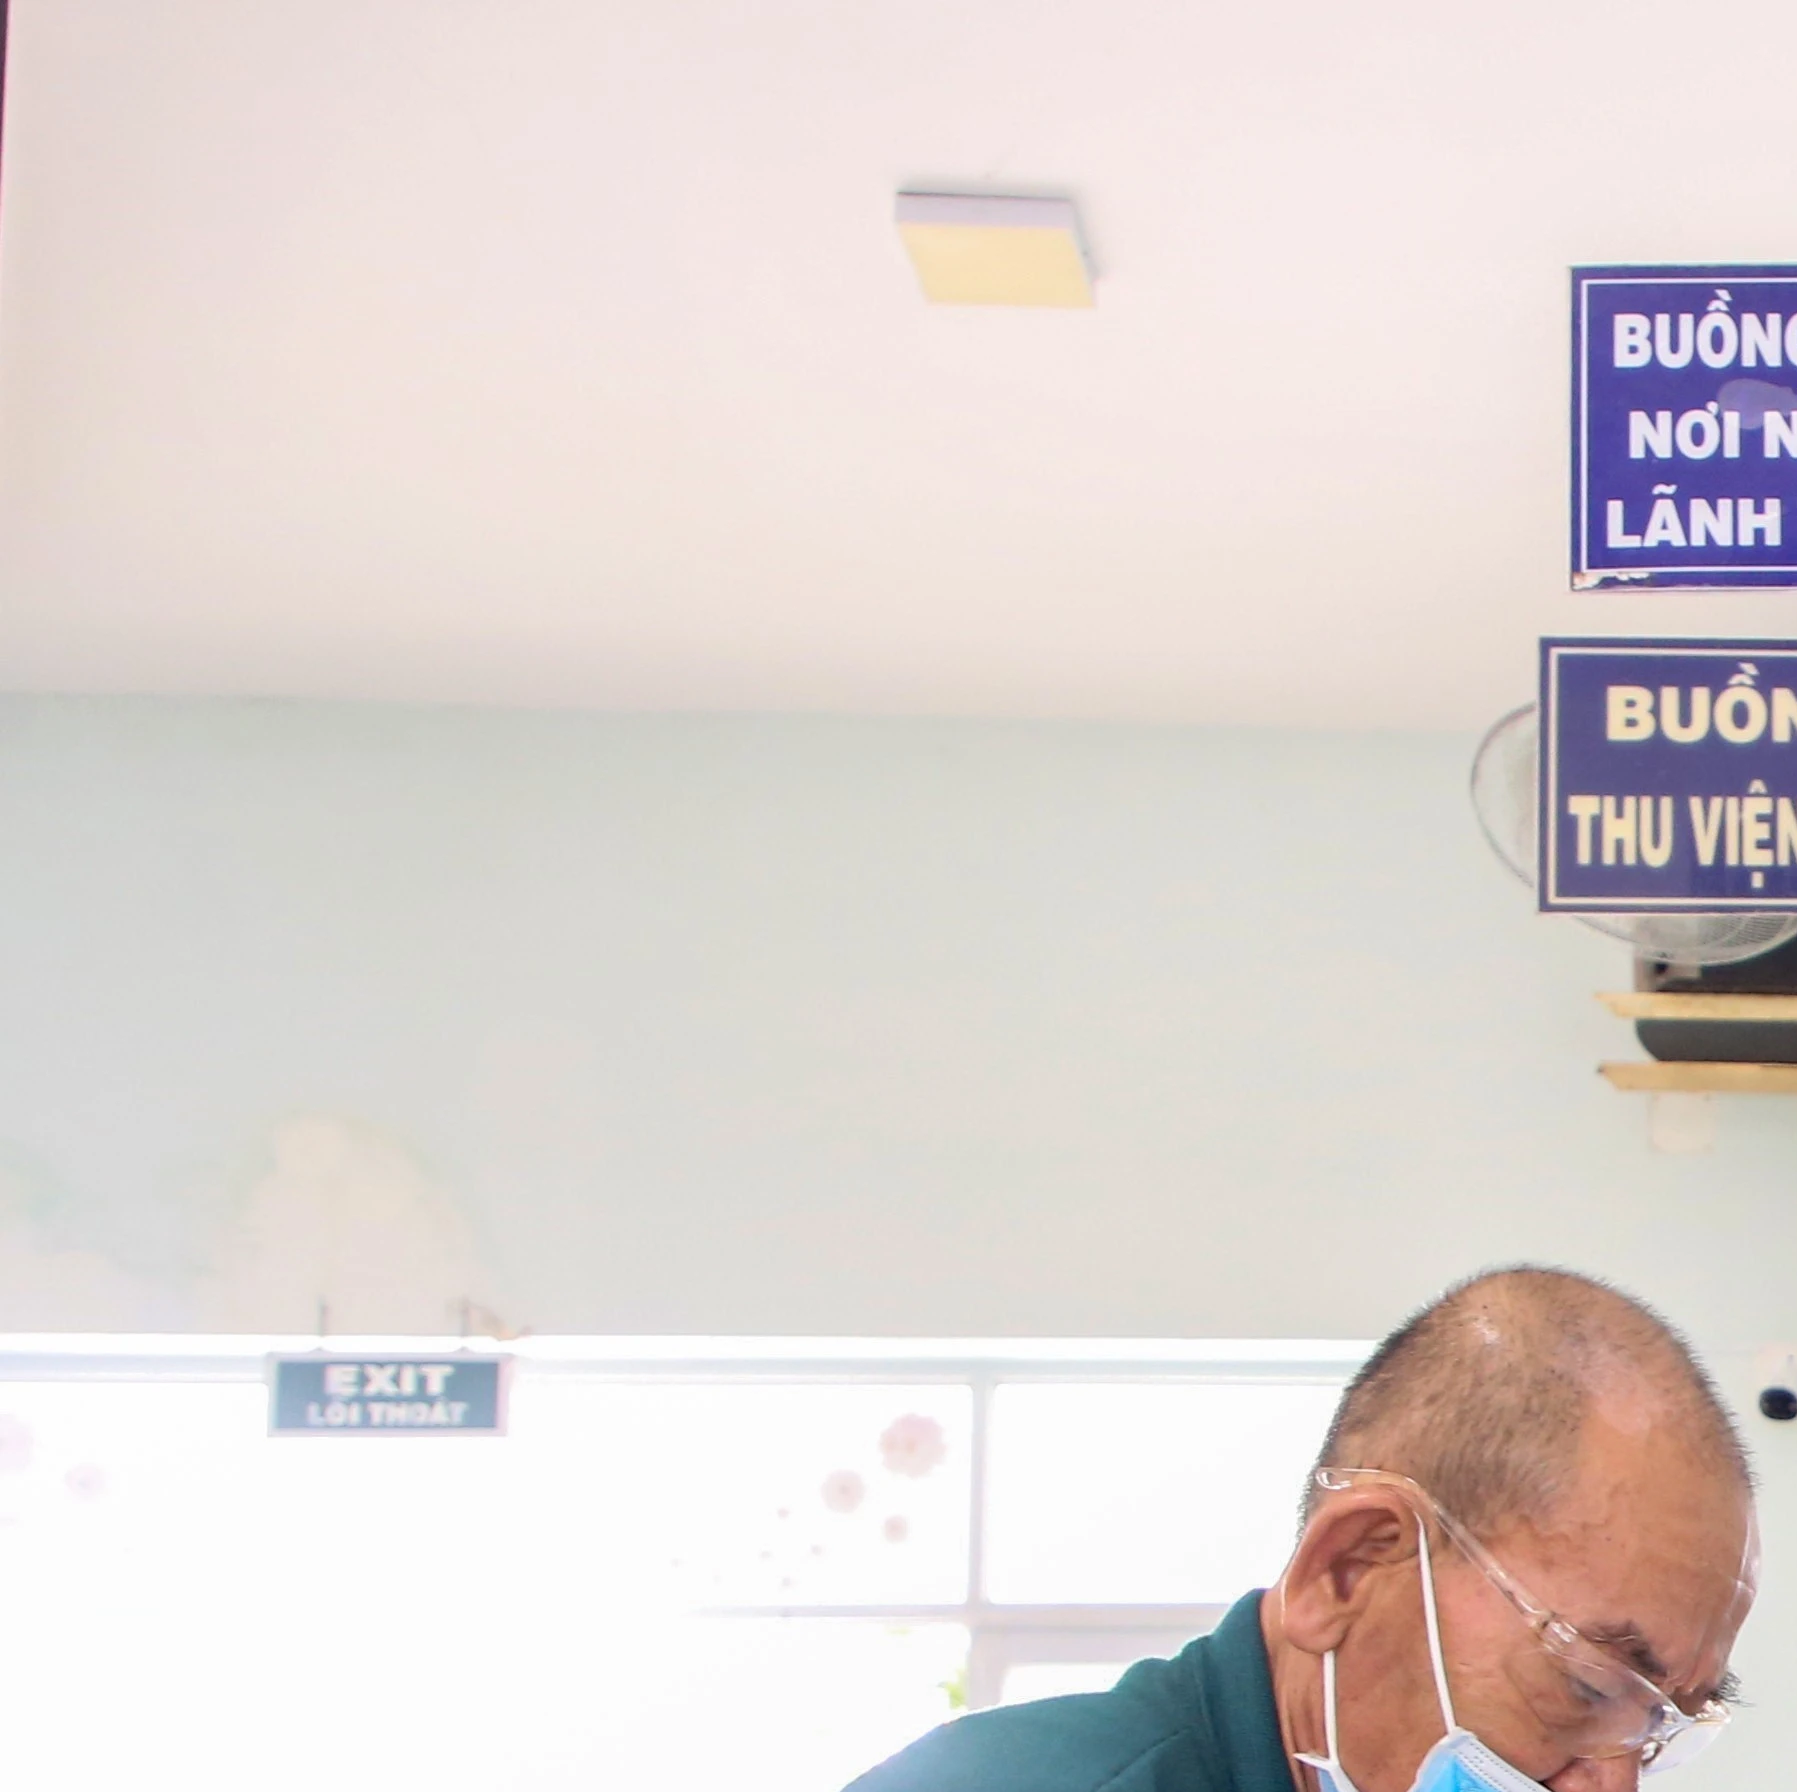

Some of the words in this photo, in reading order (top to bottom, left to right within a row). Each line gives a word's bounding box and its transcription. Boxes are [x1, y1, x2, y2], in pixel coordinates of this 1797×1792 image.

[1628, 403, 1740, 459] NƠI
[1606, 486, 1783, 548] LÃNH
[1568, 795, 1674, 868] THU
[324, 1363, 454, 1397] EXIT
